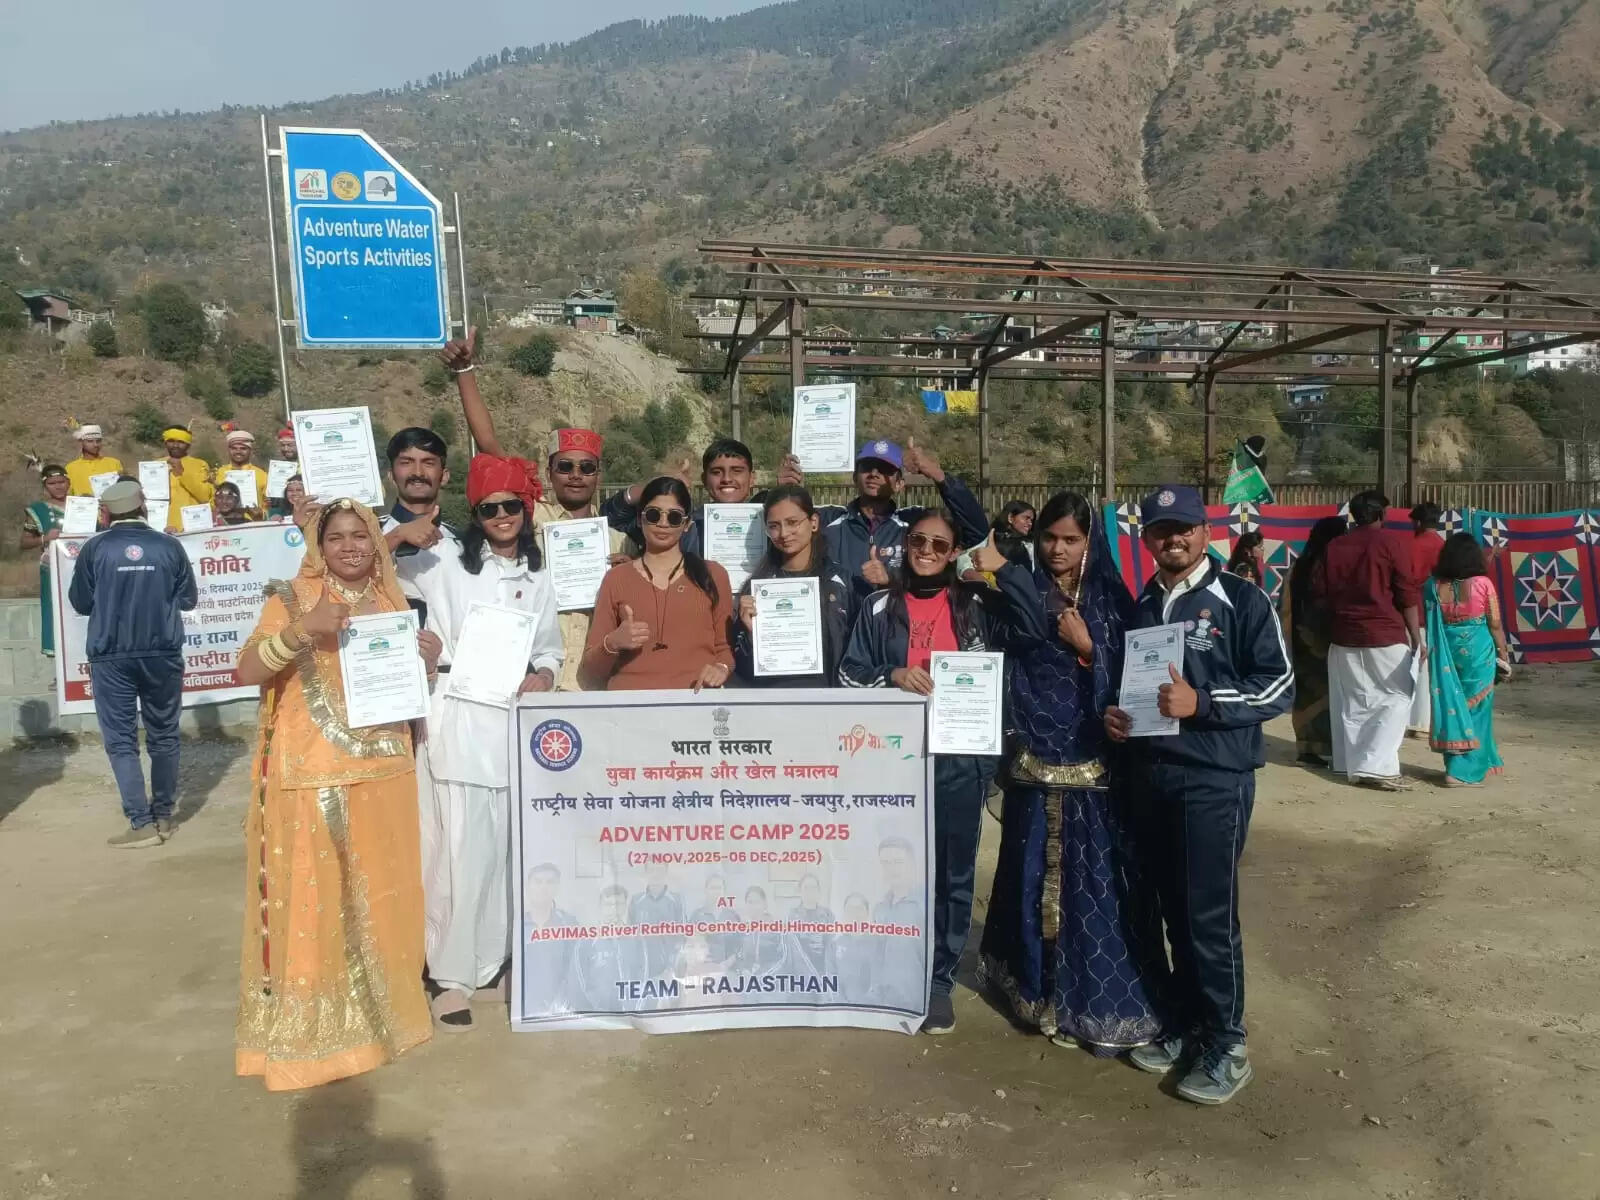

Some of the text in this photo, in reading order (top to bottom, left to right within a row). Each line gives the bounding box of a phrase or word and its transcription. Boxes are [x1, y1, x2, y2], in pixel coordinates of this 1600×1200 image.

[303, 217, 430, 239] Adventure Water
[304, 245, 432, 269] Sports Activities
[200, 555, 251, 576] शिविर
[241, 582, 264, 592] 2025
[201, 613, 233, 625] हिमाचल
[206, 630, 239, 644] राज्य
[185, 650, 231, 669] राष्ट्रीय
[671, 740, 773, 755] भारत सरकार
[605, 760, 839, 787] युवा कार्यक्रम और खेल मंत्रालय
[531, 793, 577, 816] राष्ट्रीय
[583, 792, 613, 810] सेवा
[619, 792, 666, 809] योजना
[672, 791, 714, 811] क्षेत्रीय
[600, 823, 850, 842] ADVENTURE CAMP 2025
[627, 850, 648, 867] (27
[750, 849, 823, 865] DEC,2025)
[717, 896, 736, 908] AT
[530, 926, 597, 941] ABVIMAS
[601, 924, 638, 937] River
[641, 923, 694, 937] Rafting
[860, 922, 921, 937] Pradesh
[615, 979, 679, 1000] TEAM
[702, 975, 838, 996] RAJASTHAN
